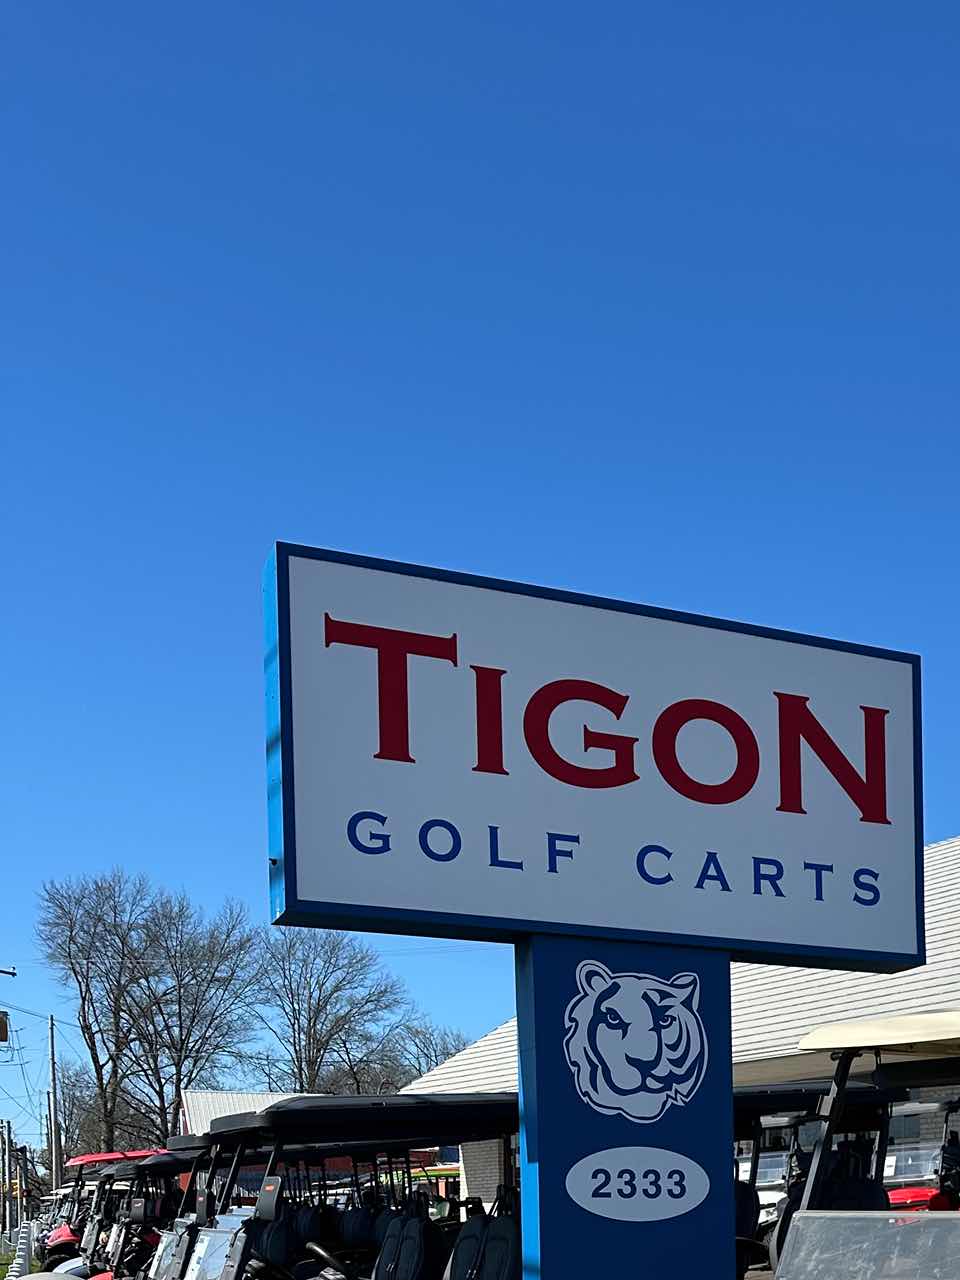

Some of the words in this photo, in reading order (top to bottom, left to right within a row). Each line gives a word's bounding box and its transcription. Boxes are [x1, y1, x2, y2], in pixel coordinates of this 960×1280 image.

[324, 612, 891, 825] TIGON
[346, 810, 580, 874] GOLF
[636, 844, 881, 906] CARTS
[591, 1168, 687, 1199] 2333
